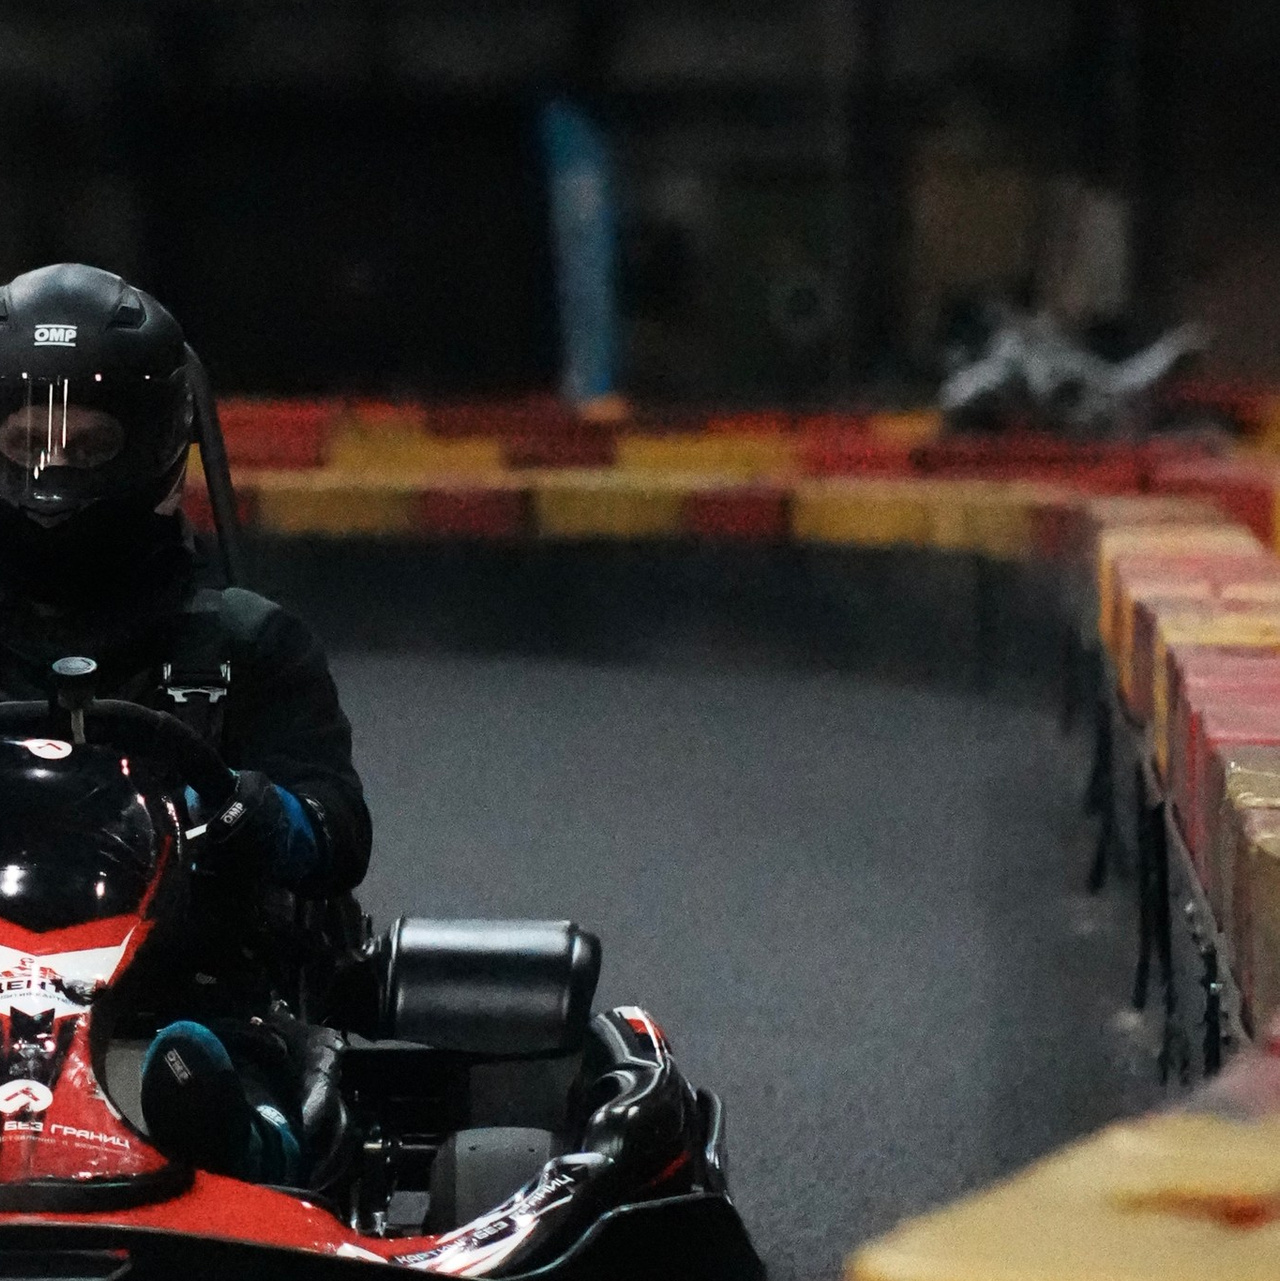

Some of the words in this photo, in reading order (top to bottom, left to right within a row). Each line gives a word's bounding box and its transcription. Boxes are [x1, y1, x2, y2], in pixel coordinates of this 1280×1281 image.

[34, 327, 77, 342] OMP
[223, 802, 243, 824] OMP
[4, 1120, 44, 1132] БЕЗ
[50, 1123, 131, 1149] ГРАНИЦ
